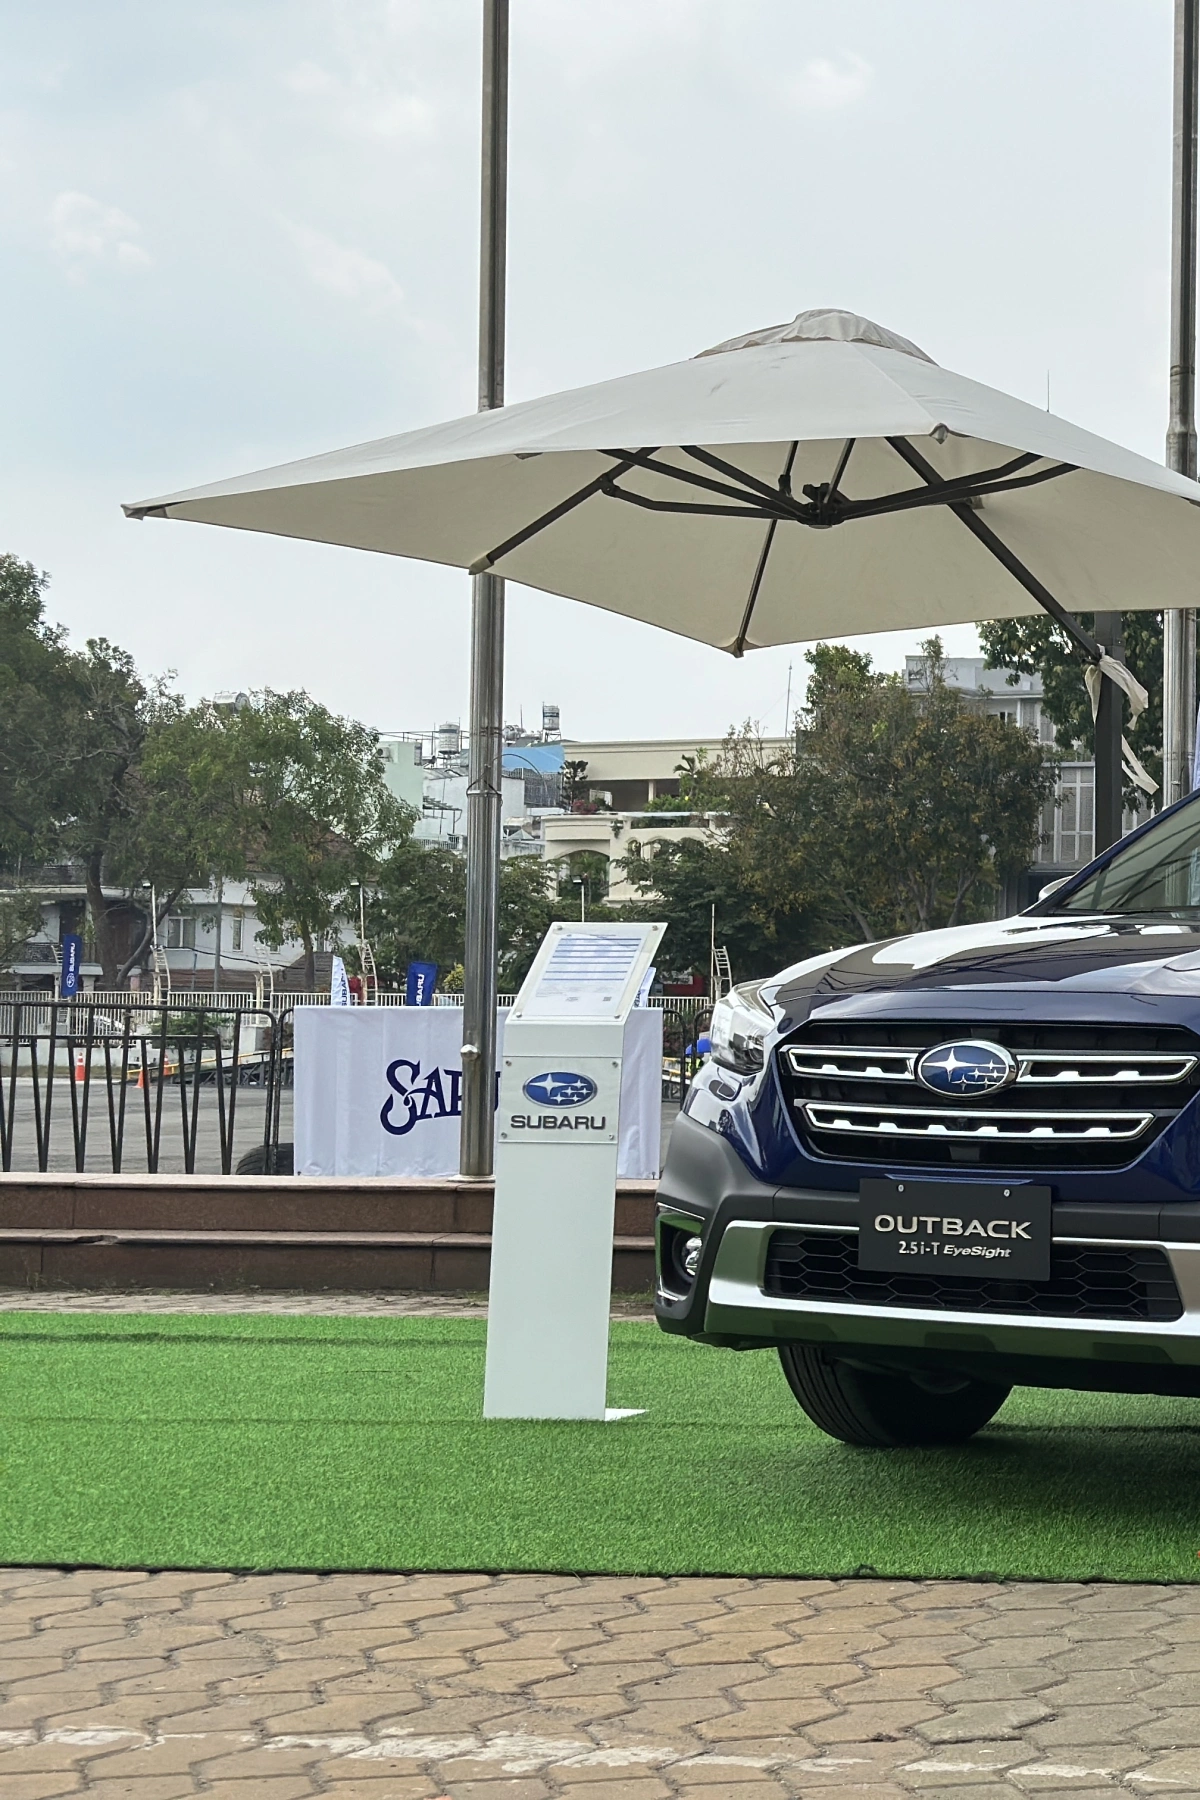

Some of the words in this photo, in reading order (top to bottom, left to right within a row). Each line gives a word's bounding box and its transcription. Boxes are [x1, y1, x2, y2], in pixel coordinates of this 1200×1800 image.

[416, 974, 425, 1006] UBARU
[510, 1115, 606, 1130] SUBARU
[874, 1214, 1032, 1240] OUTBACK
[943, 1244, 1012, 1259] EyeSight
